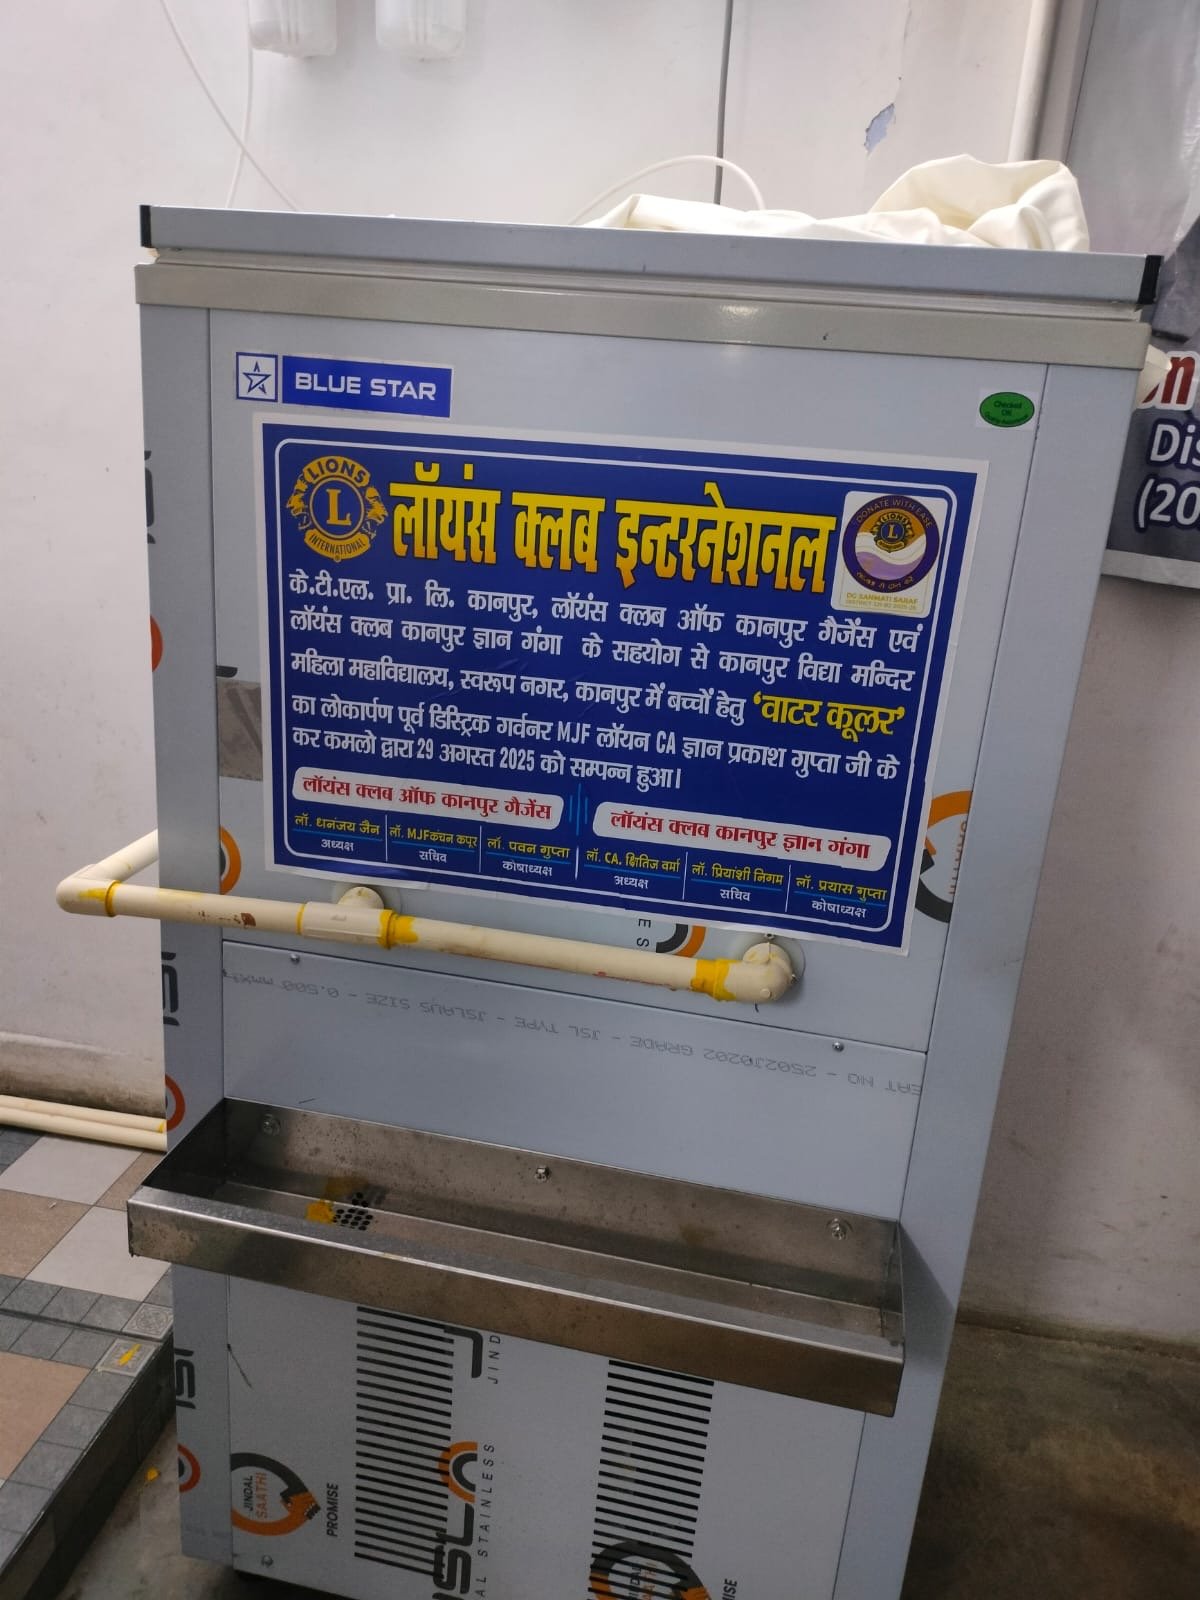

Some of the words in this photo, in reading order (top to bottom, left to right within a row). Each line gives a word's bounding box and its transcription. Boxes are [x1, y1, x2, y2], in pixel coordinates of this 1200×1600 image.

[295, 372, 361, 394] BLUE
[370, 377, 437, 400] STAR
[307, 458, 366, 483] LIONS
[326, 489, 352, 526] L
[856, 499, 889, 522] DONATE
[892, 499, 915, 510] WITH
[916, 507, 933, 528] EASE
[389, 461, 502, 565] लॉयंस
[511, 491, 606, 574] क्लब
[615, 481, 837, 593] इन्टरनेशनल
[887, 524, 898, 539] L
[309, 534, 366, 555] INTERNATIONAL
[289, 569, 374, 601] के.टी.एल.
[386, 581, 413, 605] प्रा.
[425, 579, 455, 608] लि.
[467, 589, 538, 623] कानपुर,
[551, 592, 609, 622] लॉयंस
[619, 603, 666, 627] क्लब
[677, 603, 724, 632] ऑफ
[736, 614, 808, 648] कानपुर
[818, 616, 877, 648] गैजेंस
[888, 624, 924, 653] एवं
[289, 605, 342, 634] लॉयंस
[350, 616, 393, 639] क्लब
[401, 620, 466, 652] कानपुर
[473, 628, 513, 650] ज्ञान
[521, 625, 563, 655] गंगा
[582, 632, 603, 659] के
[612, 638, 682, 667] सहयोग
[691, 643, 710, 670] से
[719, 650, 790, 685] कानपुर
[798, 652, 843, 683] विद्या
[851, 659, 916, 691] मन्दिर
[291, 648, 344, 676] महिला
[348, 655, 454, 690] महाविद्यालय,
[460, 669, 516, 693] स्वरूप
[521, 675, 568, 703] नगर,
[575, 681, 643, 714] कानपुर
[645, 682, 666, 709] में
[667, 687, 715, 715] बच्चों
[715, 690, 746, 726] हेतु
[292, 695, 316, 715] का
[320, 694, 393, 724] लोकार्पण
[398, 702, 426, 734] पूर्व
[429, 703, 492, 737] डिस्ट्रिक
[496, 713, 554, 741] गर्वनर
[557, 720, 591, 744] MJF
[596, 722, 651, 752] लॉयन
[656, 730, 676, 755] CA
[682, 736, 724, 760] ज्ञान
[728, 742, 787, 768] प्रकाश
[791, 749, 841, 778] गुप्ता
[845, 750, 872, 777] जी
[876, 754, 901, 780] के
[292, 727, 321, 748] कर
[324, 730, 377, 754] कमलो
[381, 737, 414, 759] द्वारा
[416, 738, 434, 760] 29
[439, 743, 495, 768] अगस्त
[500, 747, 535, 772] 2025
[540, 750, 566, 776] को
[570, 757, 633, 783] सम्पन्न
[302, 773, 350, 797] लॉयंस
[355, 783, 393, 801] क्लब
[398, 785, 435, 805] ऑफ
[441, 793, 499, 817] कानपुर
[504, 794, 552, 820] गैजेंस
[316, 817, 356, 833] धनंजय
[359, 819, 380, 836] जैन
[610, 810, 664, 832] लॉयंस
[669, 819, 710, 838] क्लब
[716, 825, 777, 849] कानपुर
[783, 834, 822, 853] ज्ञान
[828, 836, 871, 860] गंगा
[321, 838, 354, 852] अध्यक्ष
[456, 834, 478, 849] कपूर
[508, 840, 537, 855] पवन
[540, 844, 571, 860] गुप्ता
[418, 848, 448, 863] सचिव
[604, 852, 622, 865] CA.
[625, 852, 659, 870] क्षितिज
[661, 857, 681, 873] वर्मा
[502, 859, 553, 877] कोषाध्यक्ष
[711, 864, 751, 881] प्रियांशी
[753, 868, 784, 885] निगम
[614, 875, 649, 889] अध्यक्ष
[818, 880, 853, 895] प्रयास
[856, 885, 887, 902] गुप्ता
[720, 886, 751, 902] सचिव
[811, 899, 867, 918] कोषाध्यक्ष
[366, 992, 411, 1011] SIZE
[515, 1016, 559, 1034] TYPE
[568, 1025, 600, 1041] JSL
[630, 1035, 693, 1057] GRADE
[243, 1475, 254, 1512] JINDAL
[255, 1471, 268, 1519] SAATHI
[478, 1444, 495, 1558] STAINLESS
[326, 1482, 339, 1538] PROMISE
